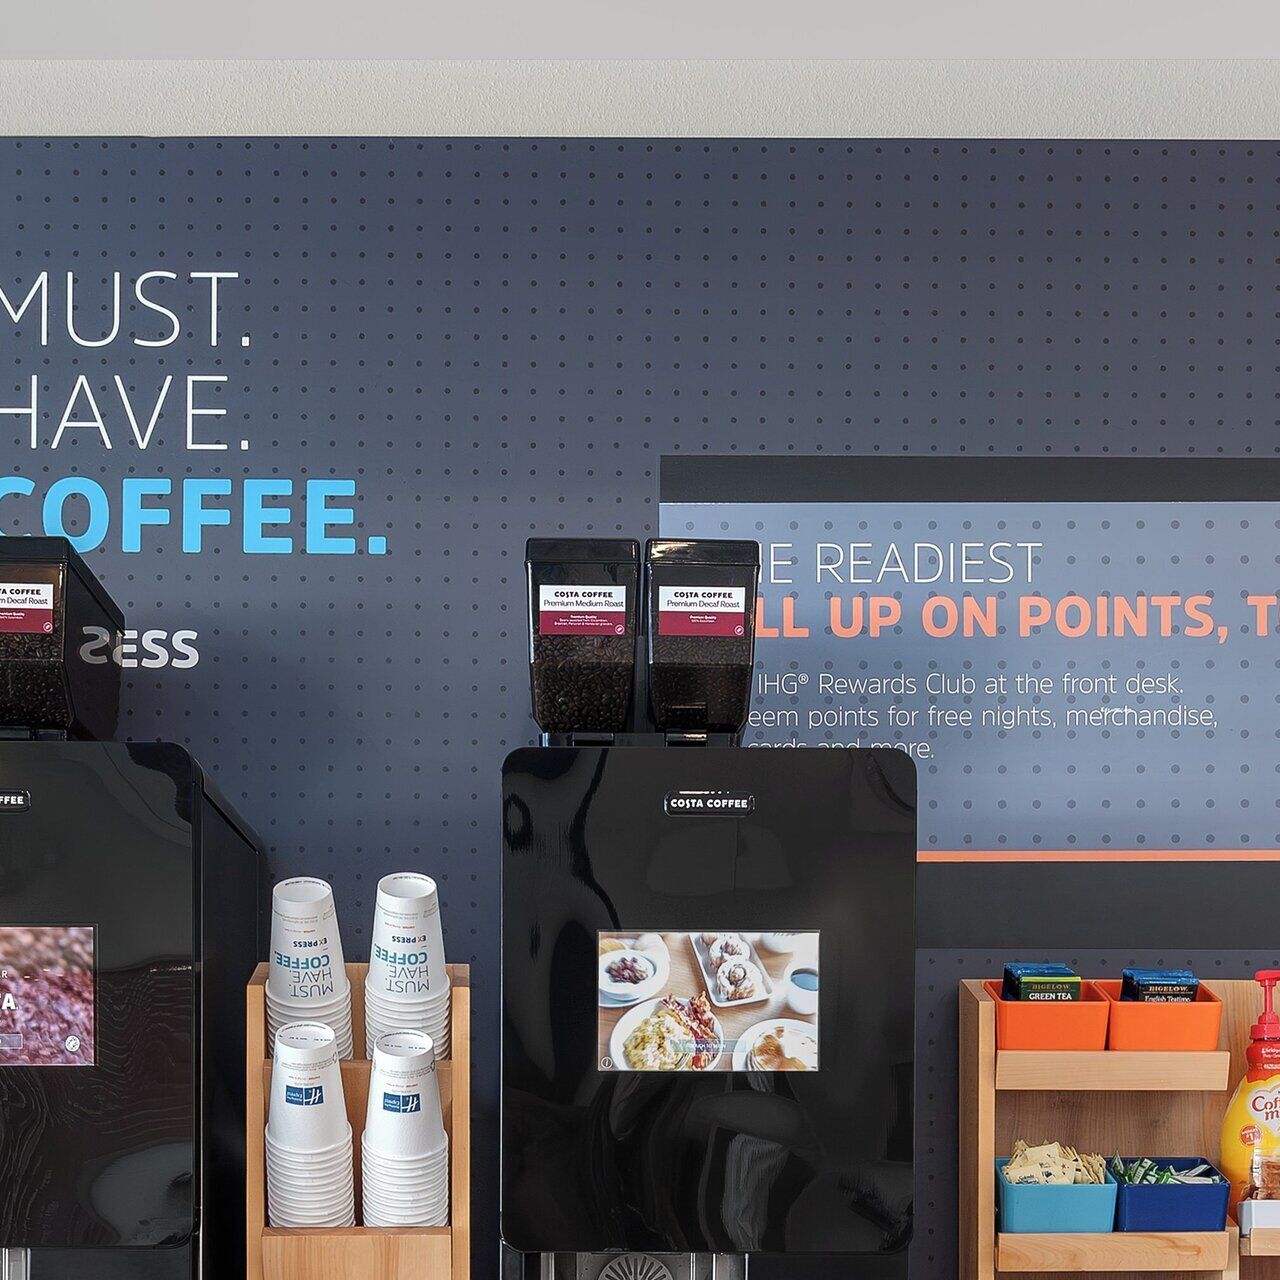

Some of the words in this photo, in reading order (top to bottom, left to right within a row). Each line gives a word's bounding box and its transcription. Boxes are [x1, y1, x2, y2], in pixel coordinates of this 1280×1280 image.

[758, 543, 793, 583] E
[816, 542, 1043, 584] READIEST
[7, 597, 28, 605] Decaf
[29, 597, 48, 605] Roast
[674, 591, 700, 599] COSTA
[604, 600, 624, 608] Roast
[667, 600, 698, 608] Premium
[699, 600, 719, 608] Decaf
[721, 600, 740, 608] Roast
[829, 595, 902, 639] UP
[921, 595, 997, 639] ON
[1019, 594, 1229, 644] POINTS,
[819, 673, 918, 694] Rewards
[926, 672, 977, 694] Club
[984, 674, 1008, 694] at
[1015, 673, 1054, 694] the
[1062, 672, 1118, 694] front
[1125, 672, 1184, 694] desk.
[808, 706, 880, 730] points
[887, 705, 920, 727] for
[927, 705, 974, 727] free
[982, 705, 1058, 729] nights,
[1066, 704, 1219, 728] merchandise,
[670, 798, 704, 809] COSTA
[707, 799, 748, 808] COFFEE
[293, 937, 328, 948] EXPRESS
[392, 934, 427, 944] EXPRESS
[274, 950, 330, 970] COFFEE.
[374, 943, 428, 965] COFFEE.
[289, 967, 332, 984] HAVE.
[386, 963, 429, 979] HAVE.
[289, 980, 334, 998] MUST.
[385, 978, 430, 993] MUST.
[1028, 992, 1055, 1000] GREEN
